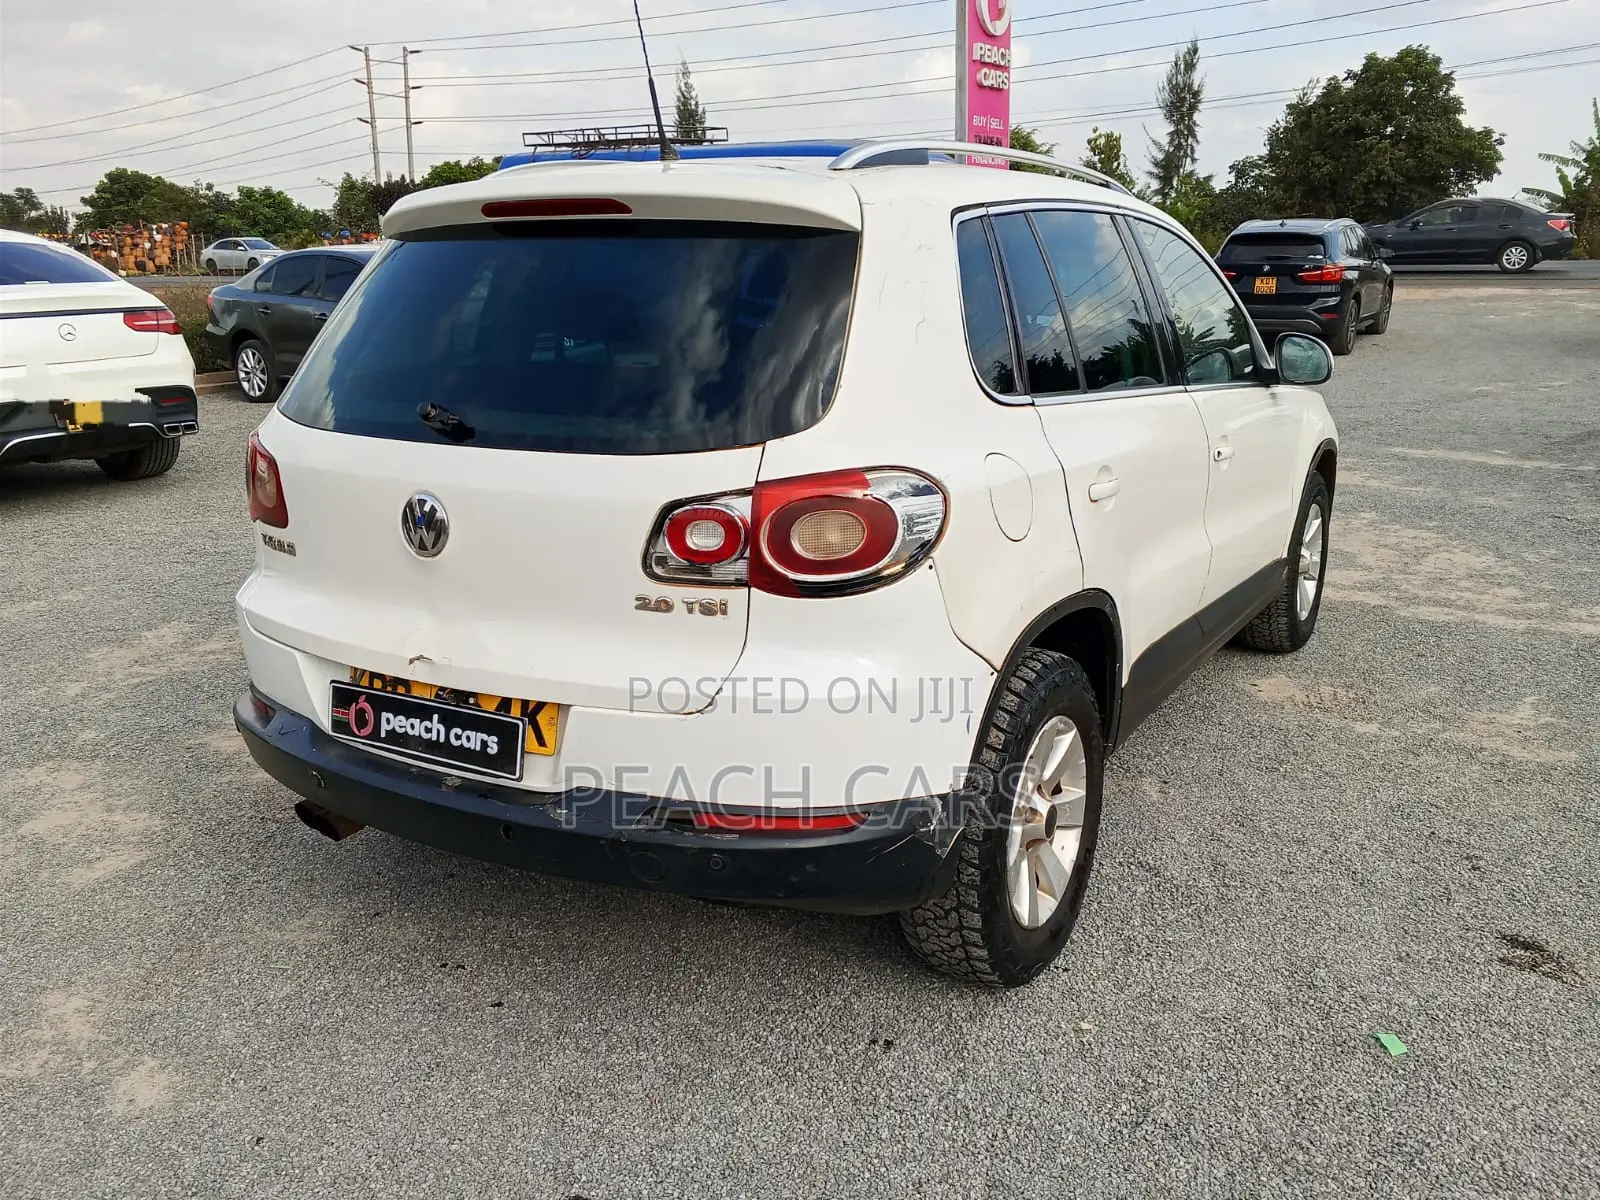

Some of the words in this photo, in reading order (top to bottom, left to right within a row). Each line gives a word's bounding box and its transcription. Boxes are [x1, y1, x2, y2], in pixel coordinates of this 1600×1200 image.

[972, 42, 1010, 66] PEACH
[977, 68, 1009, 90] CARS
[973, 115, 987, 127] BUY
[990, 117, 1004, 130] SELL
[380, 711, 445, 743] peach
[449, 727, 498, 755] cars
